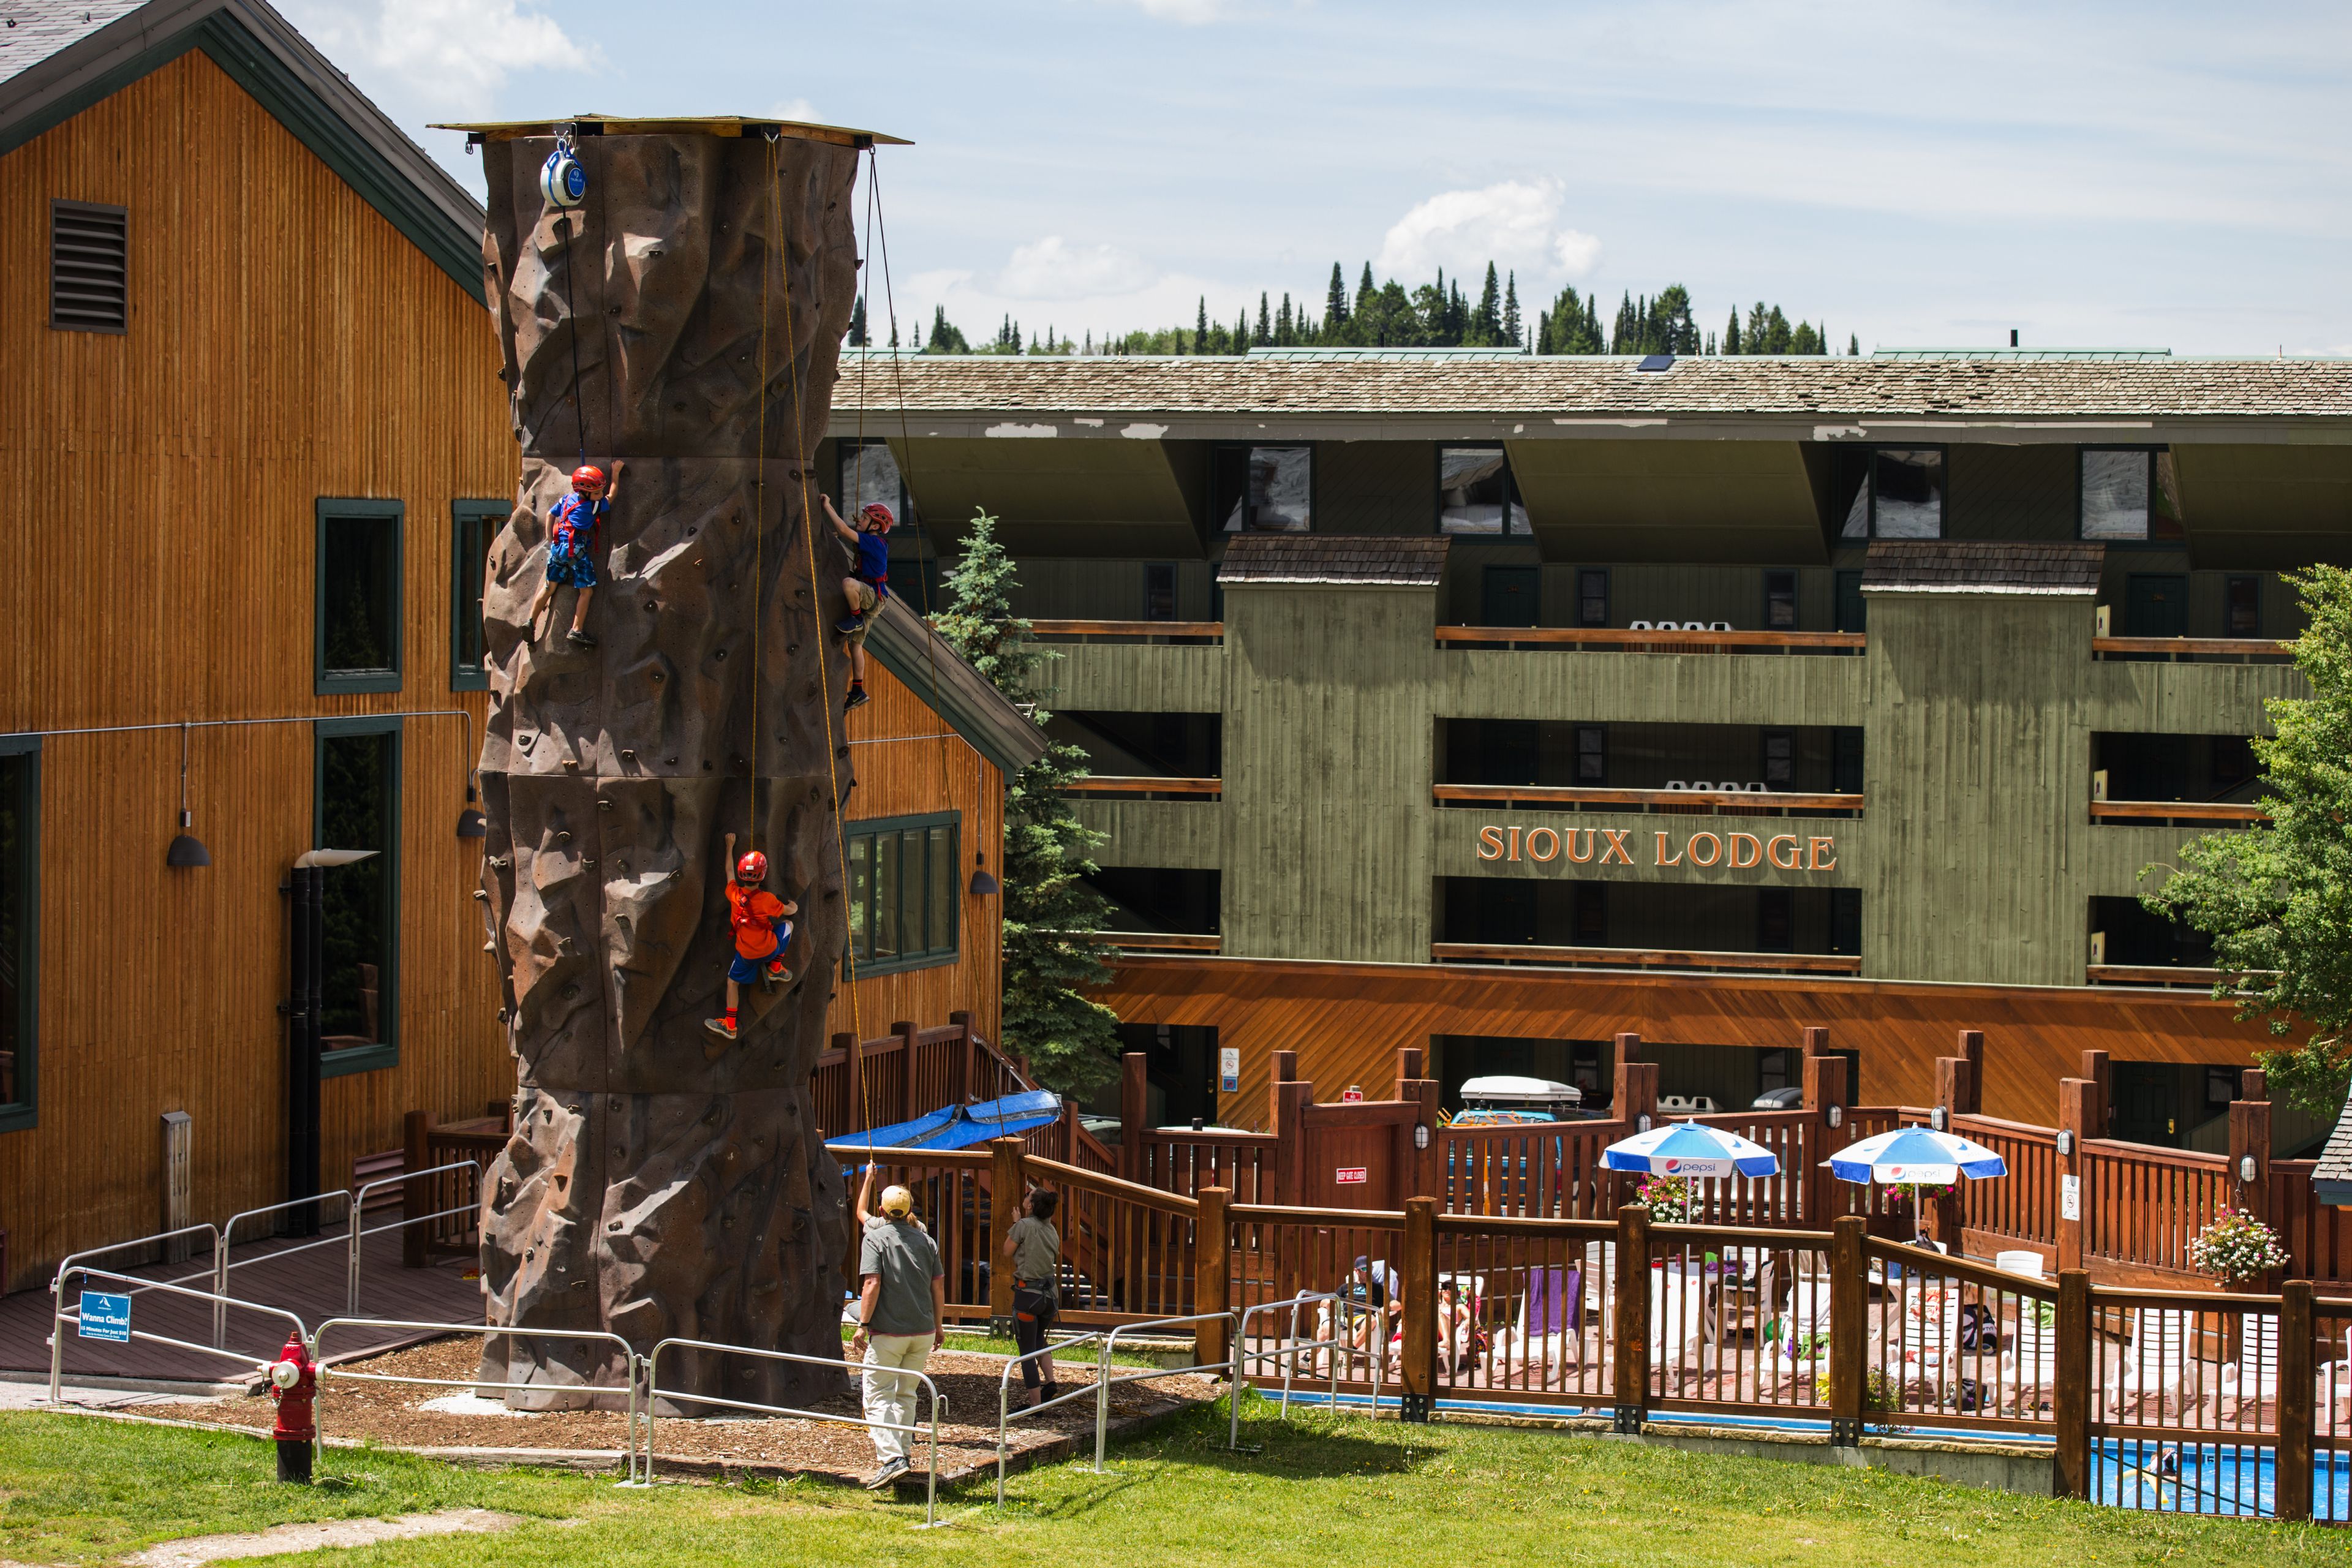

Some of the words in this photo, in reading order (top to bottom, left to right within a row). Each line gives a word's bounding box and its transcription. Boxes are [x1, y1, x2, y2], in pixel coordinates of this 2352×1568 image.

[1476, 826, 1634, 865] SIOUX
[1654, 831, 1837, 871] LODGE
[1683, 1163, 1716, 1172] pepsi
[1354, 1170, 1365, 1180] CLOSED
[1908, 1169, 1940, 1178] pepsi
[82, 1313, 104, 1322] Wanna
[106, 1315, 127, 1325] Climb?
